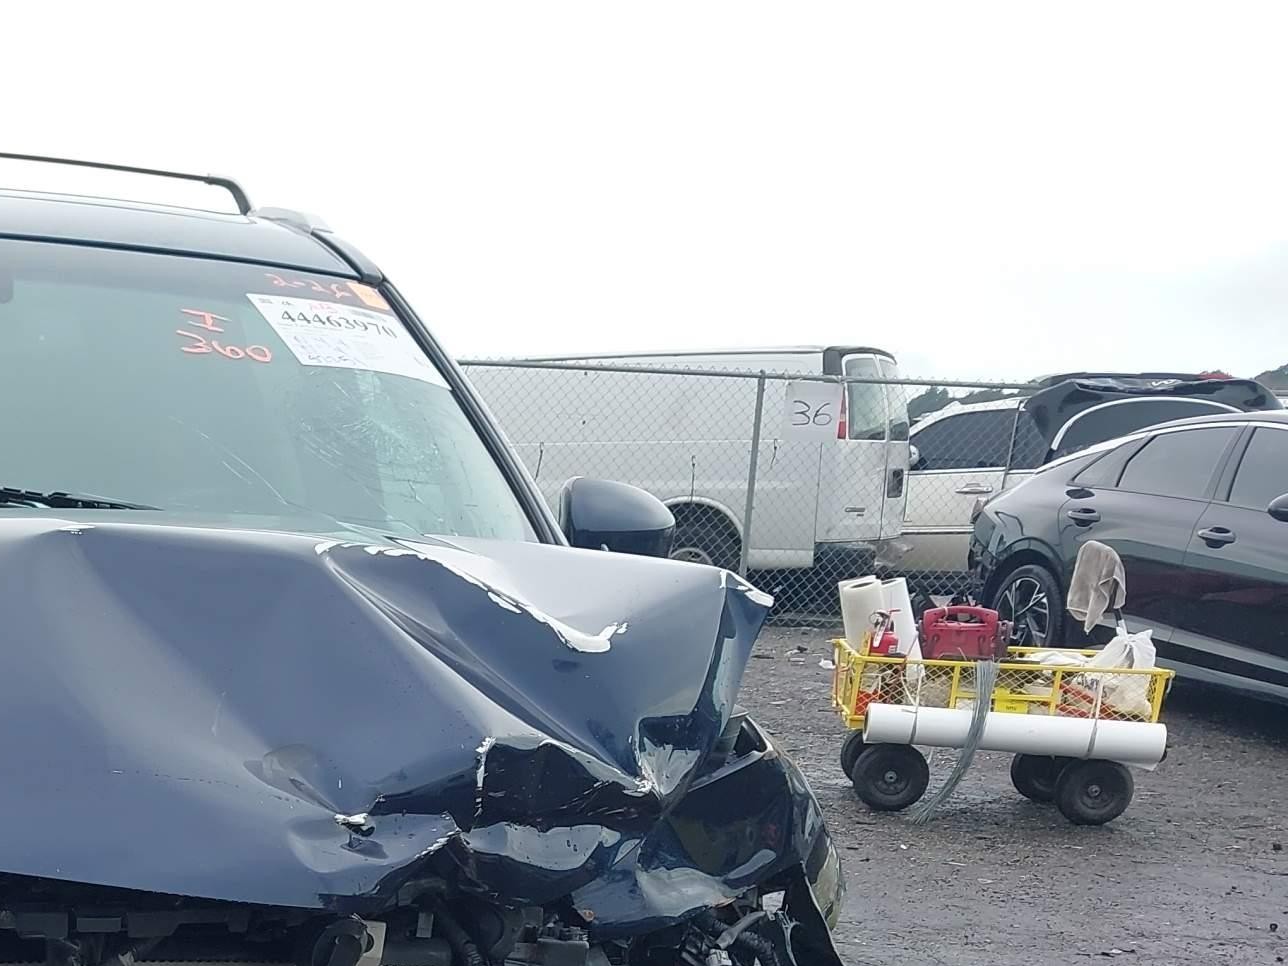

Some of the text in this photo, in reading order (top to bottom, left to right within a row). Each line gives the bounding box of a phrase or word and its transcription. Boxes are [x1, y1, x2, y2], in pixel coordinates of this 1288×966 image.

[281, 310, 399, 339] 44463970
[176, 329, 273, 363] 360
[792, 400, 833, 426] 36
